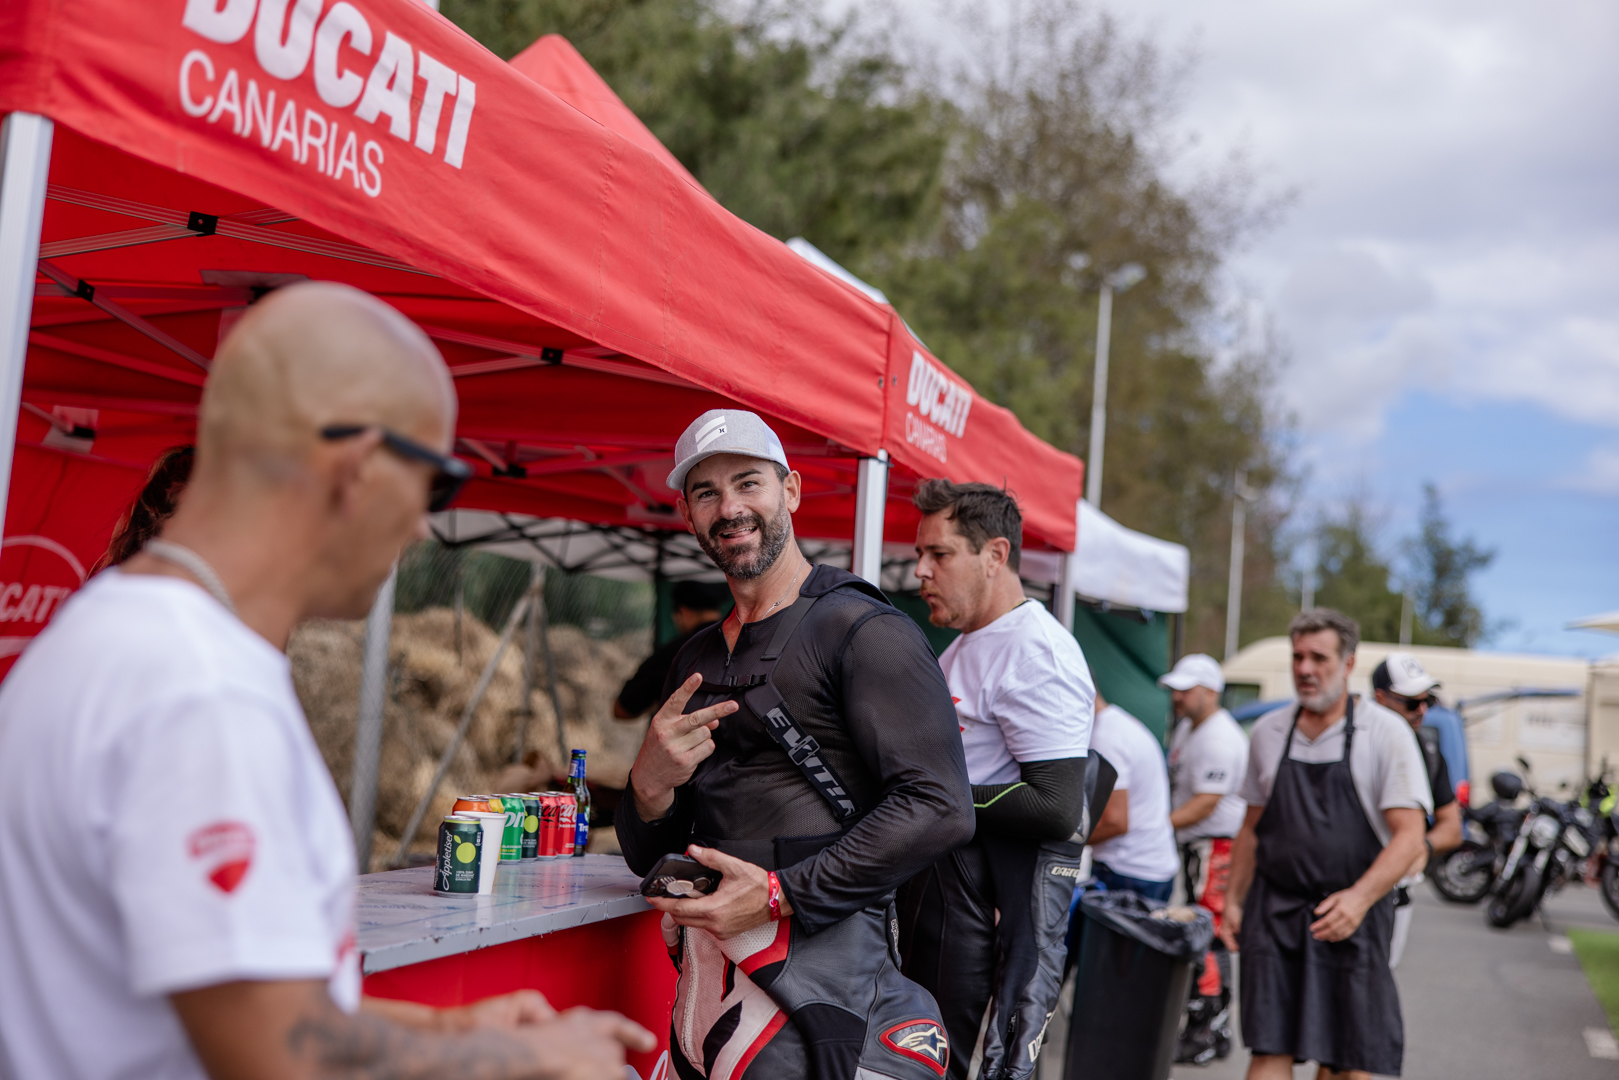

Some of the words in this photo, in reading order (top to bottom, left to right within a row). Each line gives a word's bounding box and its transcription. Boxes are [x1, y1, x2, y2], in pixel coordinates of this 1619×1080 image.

[178, 50, 385, 198] CANARIAS
[906, 349, 973, 439] DUCATI
[0, 582, 72, 623] CATI
[440, 831, 453, 891] Appletiser
